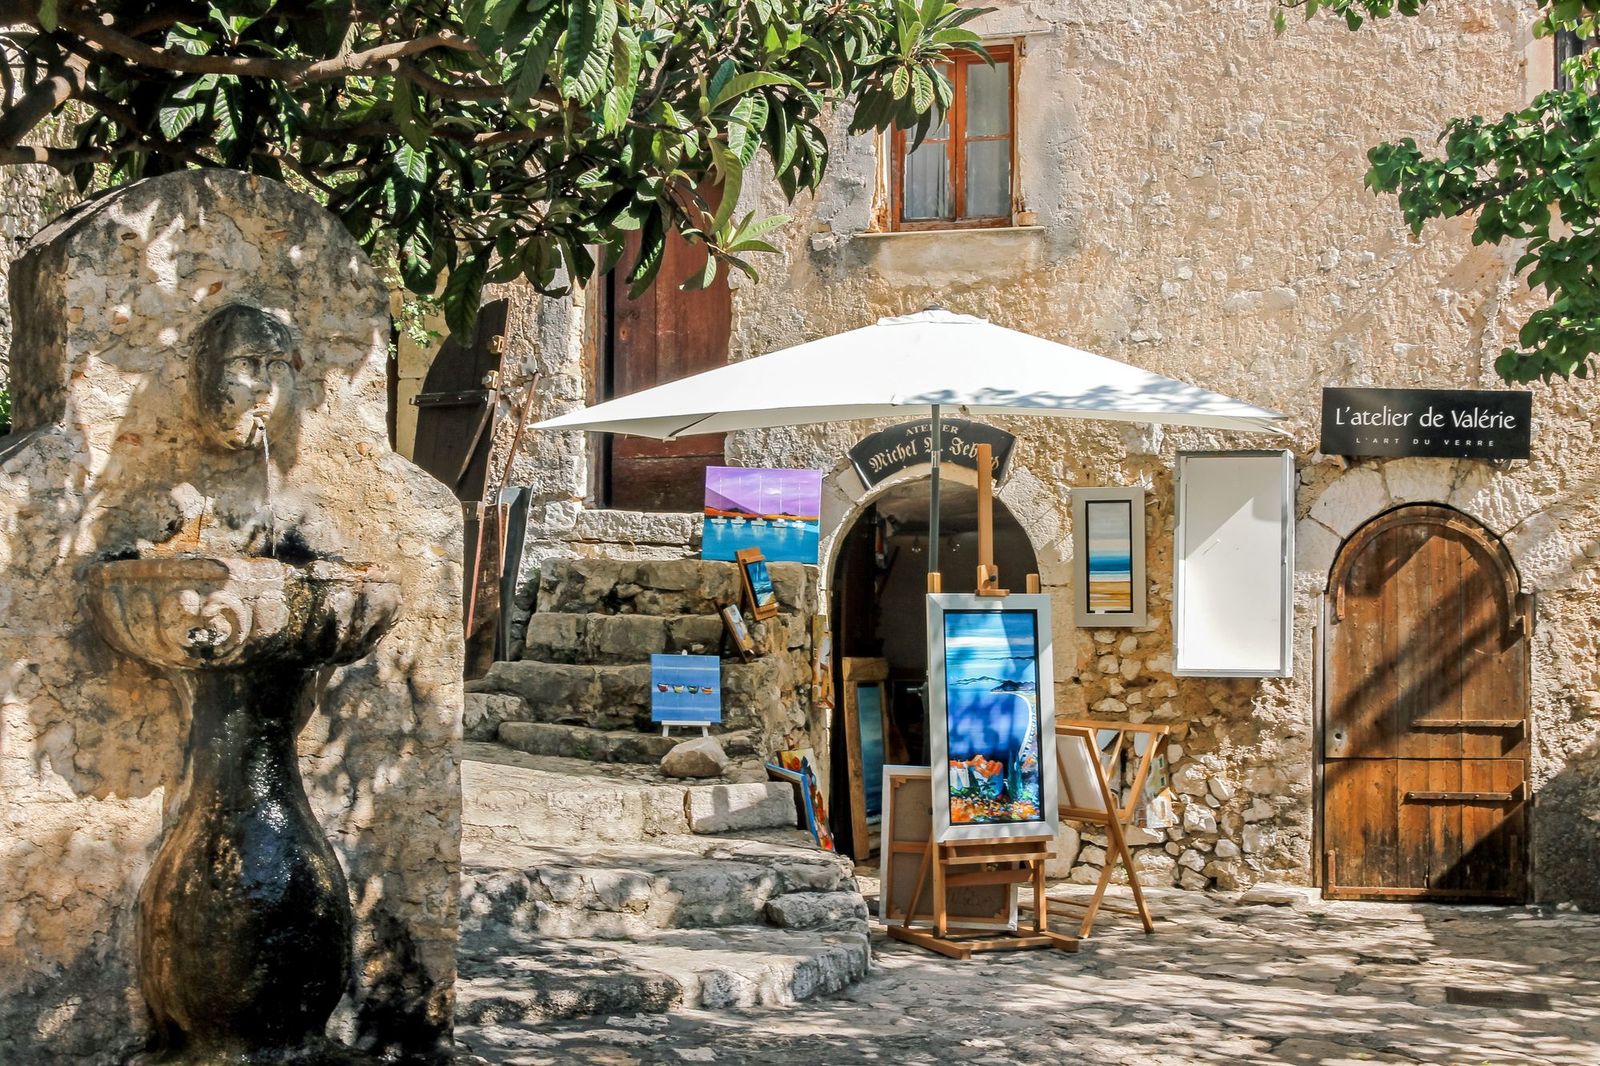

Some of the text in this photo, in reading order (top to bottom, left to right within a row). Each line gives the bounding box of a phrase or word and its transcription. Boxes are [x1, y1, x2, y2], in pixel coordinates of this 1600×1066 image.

[1419, 406, 1445, 428] de
[1451, 407, 1516, 429] Valérie
[905, 423, 958, 436] ATEER
[868, 439, 918, 473] Michel
